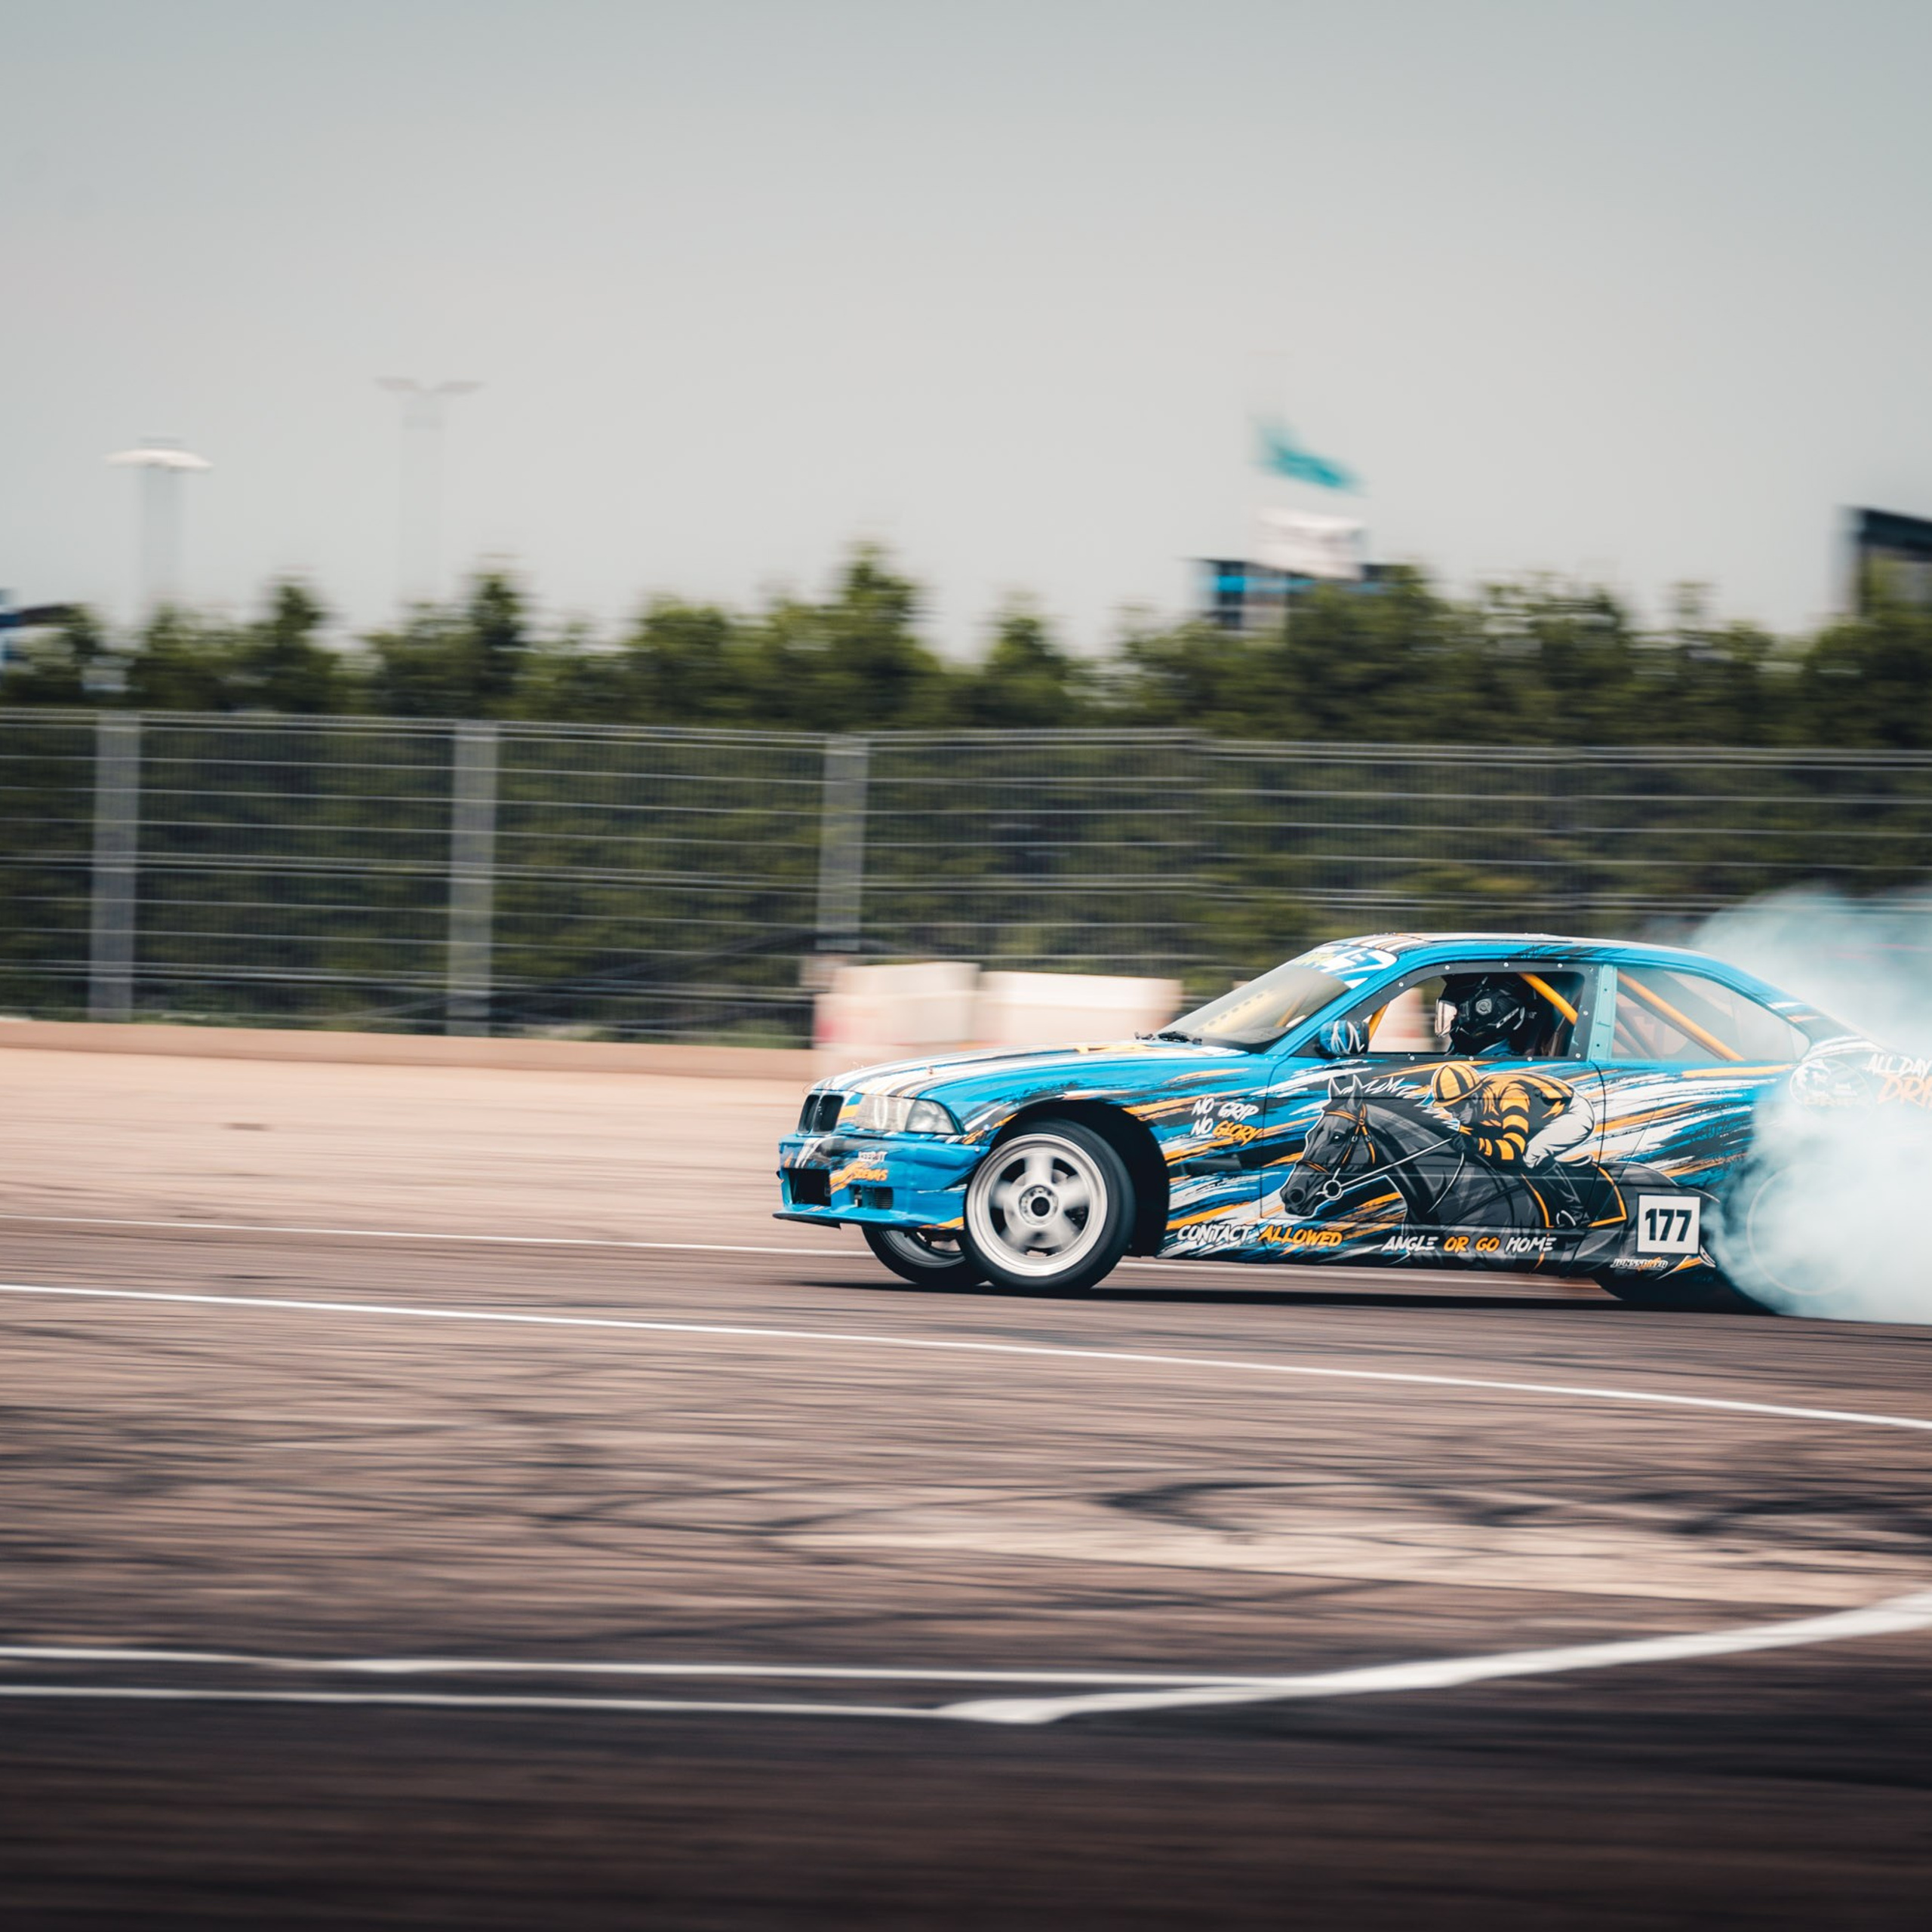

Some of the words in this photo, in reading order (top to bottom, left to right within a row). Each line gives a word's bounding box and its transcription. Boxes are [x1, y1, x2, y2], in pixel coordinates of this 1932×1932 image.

[1876, 1074, 1932, 1110] DRI
[1190, 1097, 1214, 1116] NO
[1218, 1102, 1260, 1121] GRIP
[1190, 1116, 1213, 1136] NO
[1213, 1120, 1265, 1146] GLORY
[1177, 1223, 1254, 1244] CONTACT
[1257, 1225, 1343, 1247] ALLOWED
[1644, 1208, 1693, 1242] 177
[1381, 1235, 1438, 1251] ANGLE
[1443, 1235, 1470, 1253] OR
[1475, 1237, 1501, 1252] GO
[1506, 1236, 1558, 1252] HOME
